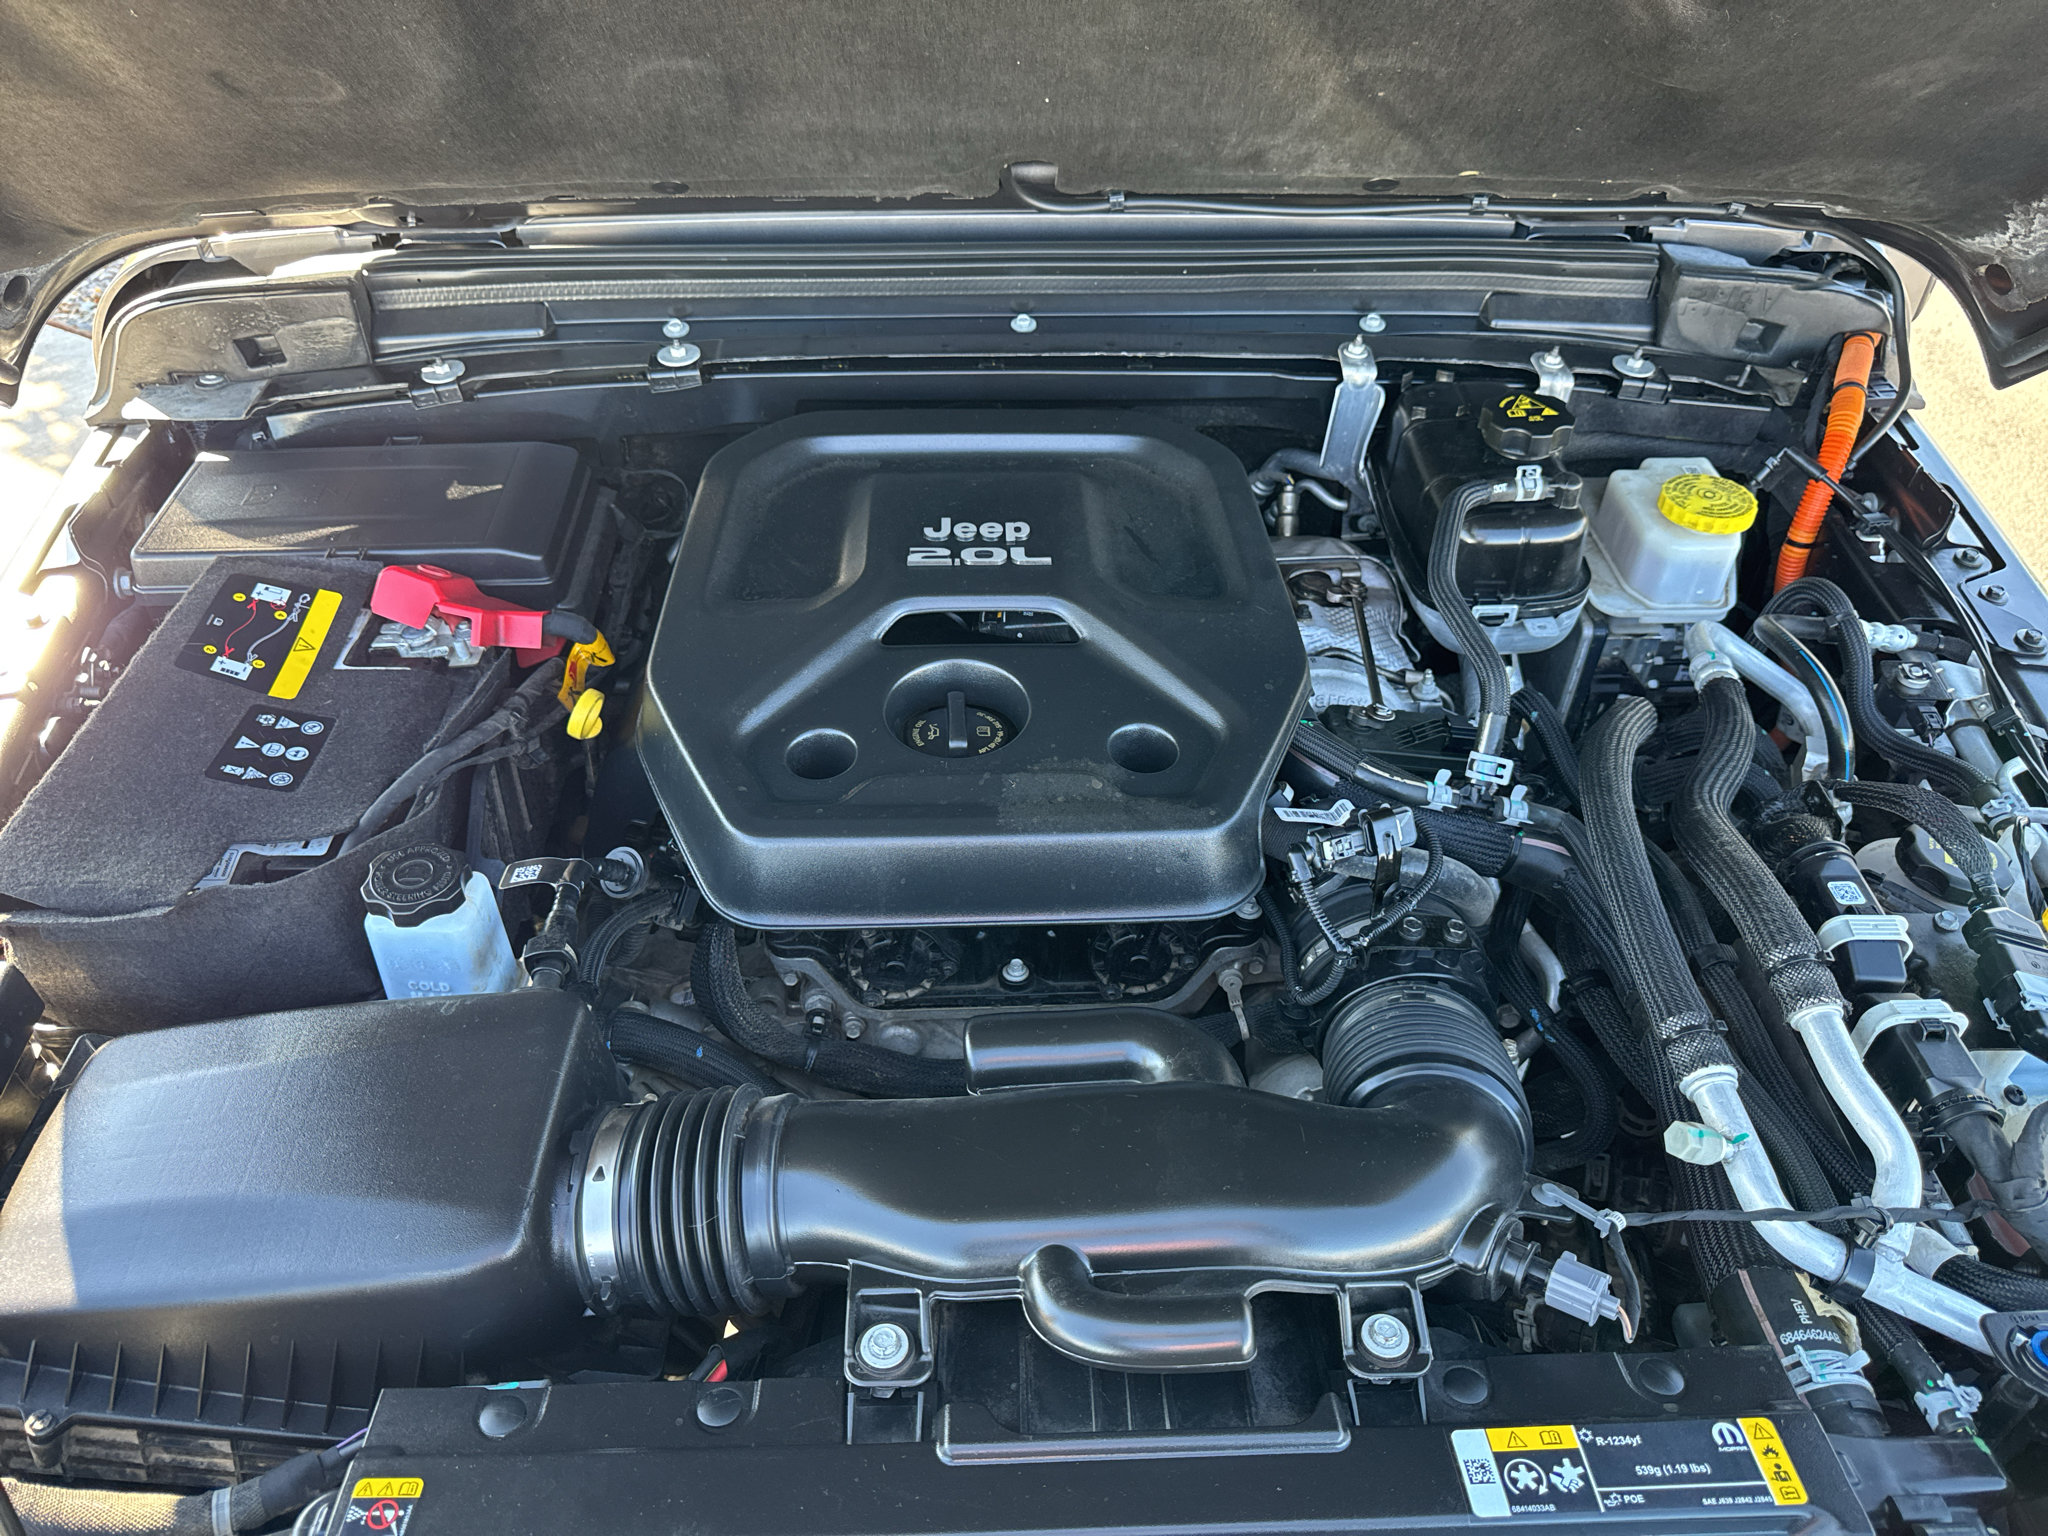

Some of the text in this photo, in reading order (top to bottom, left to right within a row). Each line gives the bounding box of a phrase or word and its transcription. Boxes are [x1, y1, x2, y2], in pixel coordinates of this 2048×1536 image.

[923, 517, 1031, 546] Jeep
[907, 547, 1053, 566] 2.0L
[912, 719, 926, 746] ENGINE OIL
[407, 845, 451, 862] APPROVED
[408, 980, 451, 993] COLD
[1790, 1298, 1813, 1325] PHEV
[1595, 1434, 1642, 1447] R-1234yf
[1635, 1462, 1712, 1477] 539g (1.19 lbs)
[1511, 1503, 1556, 1513] 68414033AB
[1623, 1494, 1646, 1504] POE
[1702, 1497, 1717, 1506] SAE
